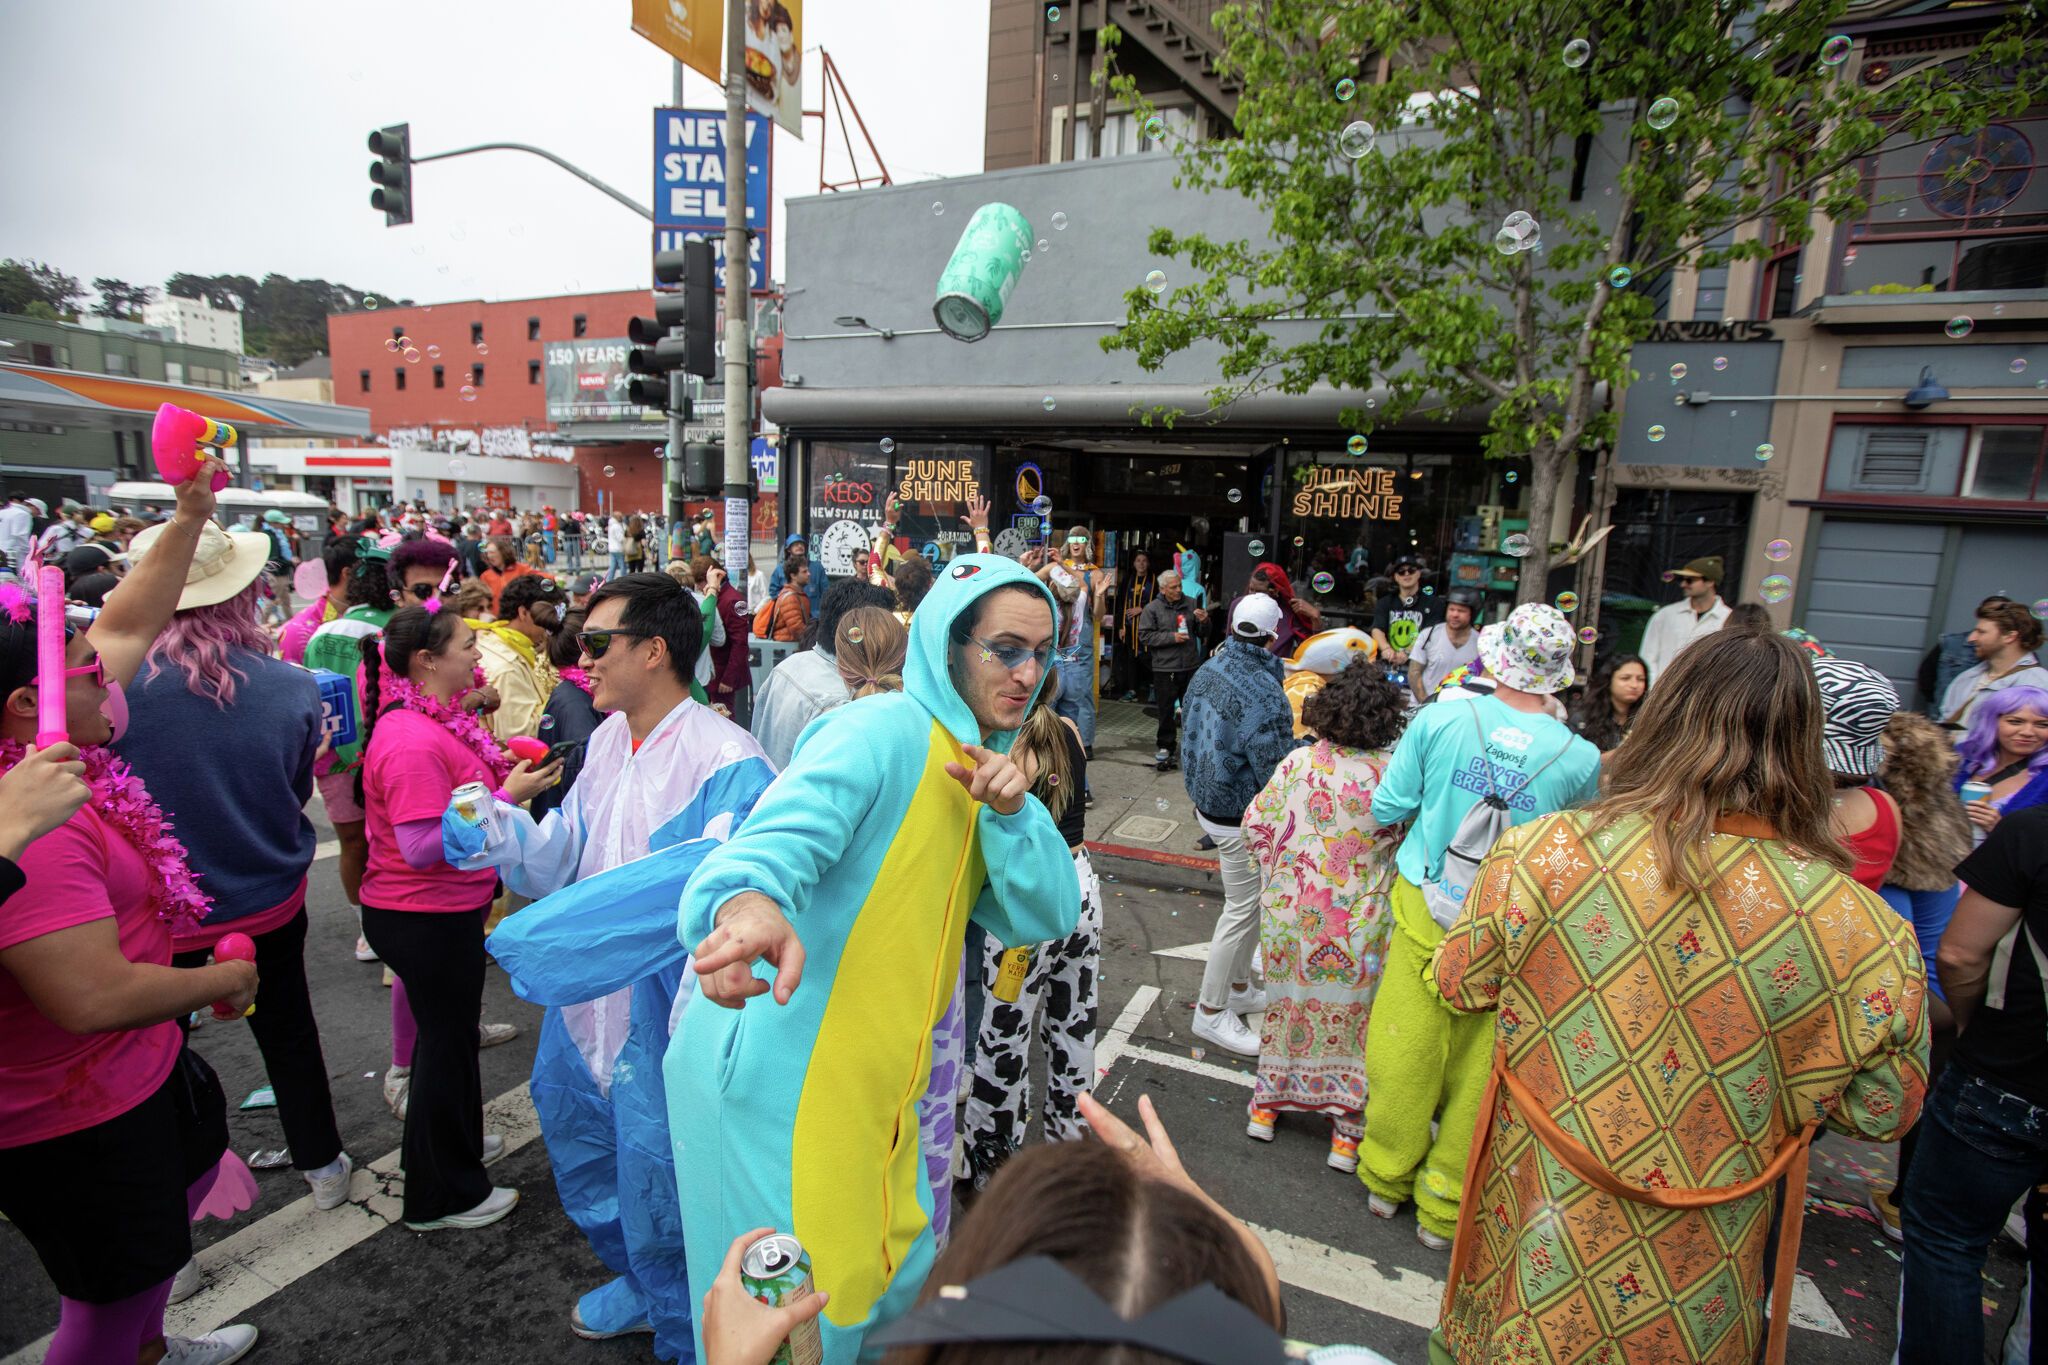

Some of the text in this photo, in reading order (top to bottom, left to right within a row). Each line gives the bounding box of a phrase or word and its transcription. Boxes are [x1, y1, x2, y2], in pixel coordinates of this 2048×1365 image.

[664, 153, 759, 183] STA-
[671, 188, 755, 218] EL
[549, 347, 626, 366] 150 YEARS
[905, 460, 973, 482] JUNE
[1302, 468, 1396, 495] JUNE
[824, 482, 873, 504] KEGS
[899, 481, 979, 502] SHINE
[862, 508, 882, 521] ELL
[1292, 492, 1403, 520] SHINE
[823, 522, 868, 556] JUNESHIN
[1485, 742, 1520, 764] Zappos
[1505, 769, 1529, 791] TO
